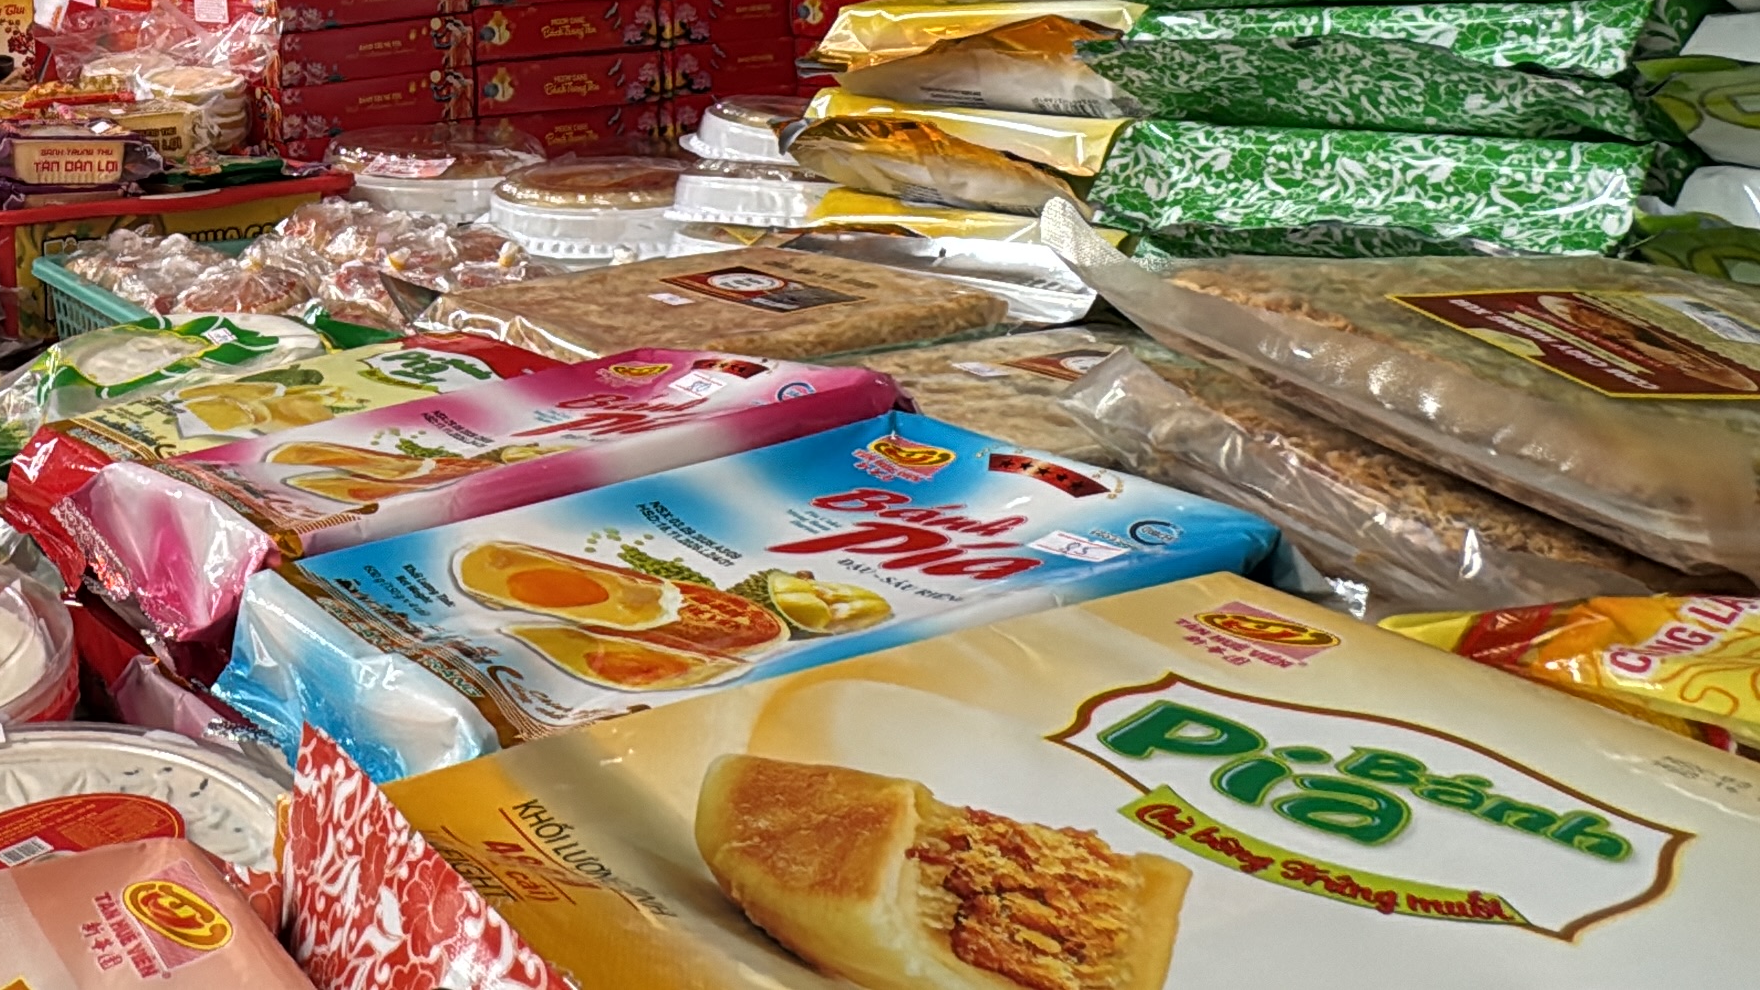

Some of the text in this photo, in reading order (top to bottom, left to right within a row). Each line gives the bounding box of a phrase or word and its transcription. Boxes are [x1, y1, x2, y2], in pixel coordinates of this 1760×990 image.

[809, 488, 1030, 537] Bánh
[1097, 699, 1636, 862] Pía Bánh
[512, 798, 575, 846] KHỐI
